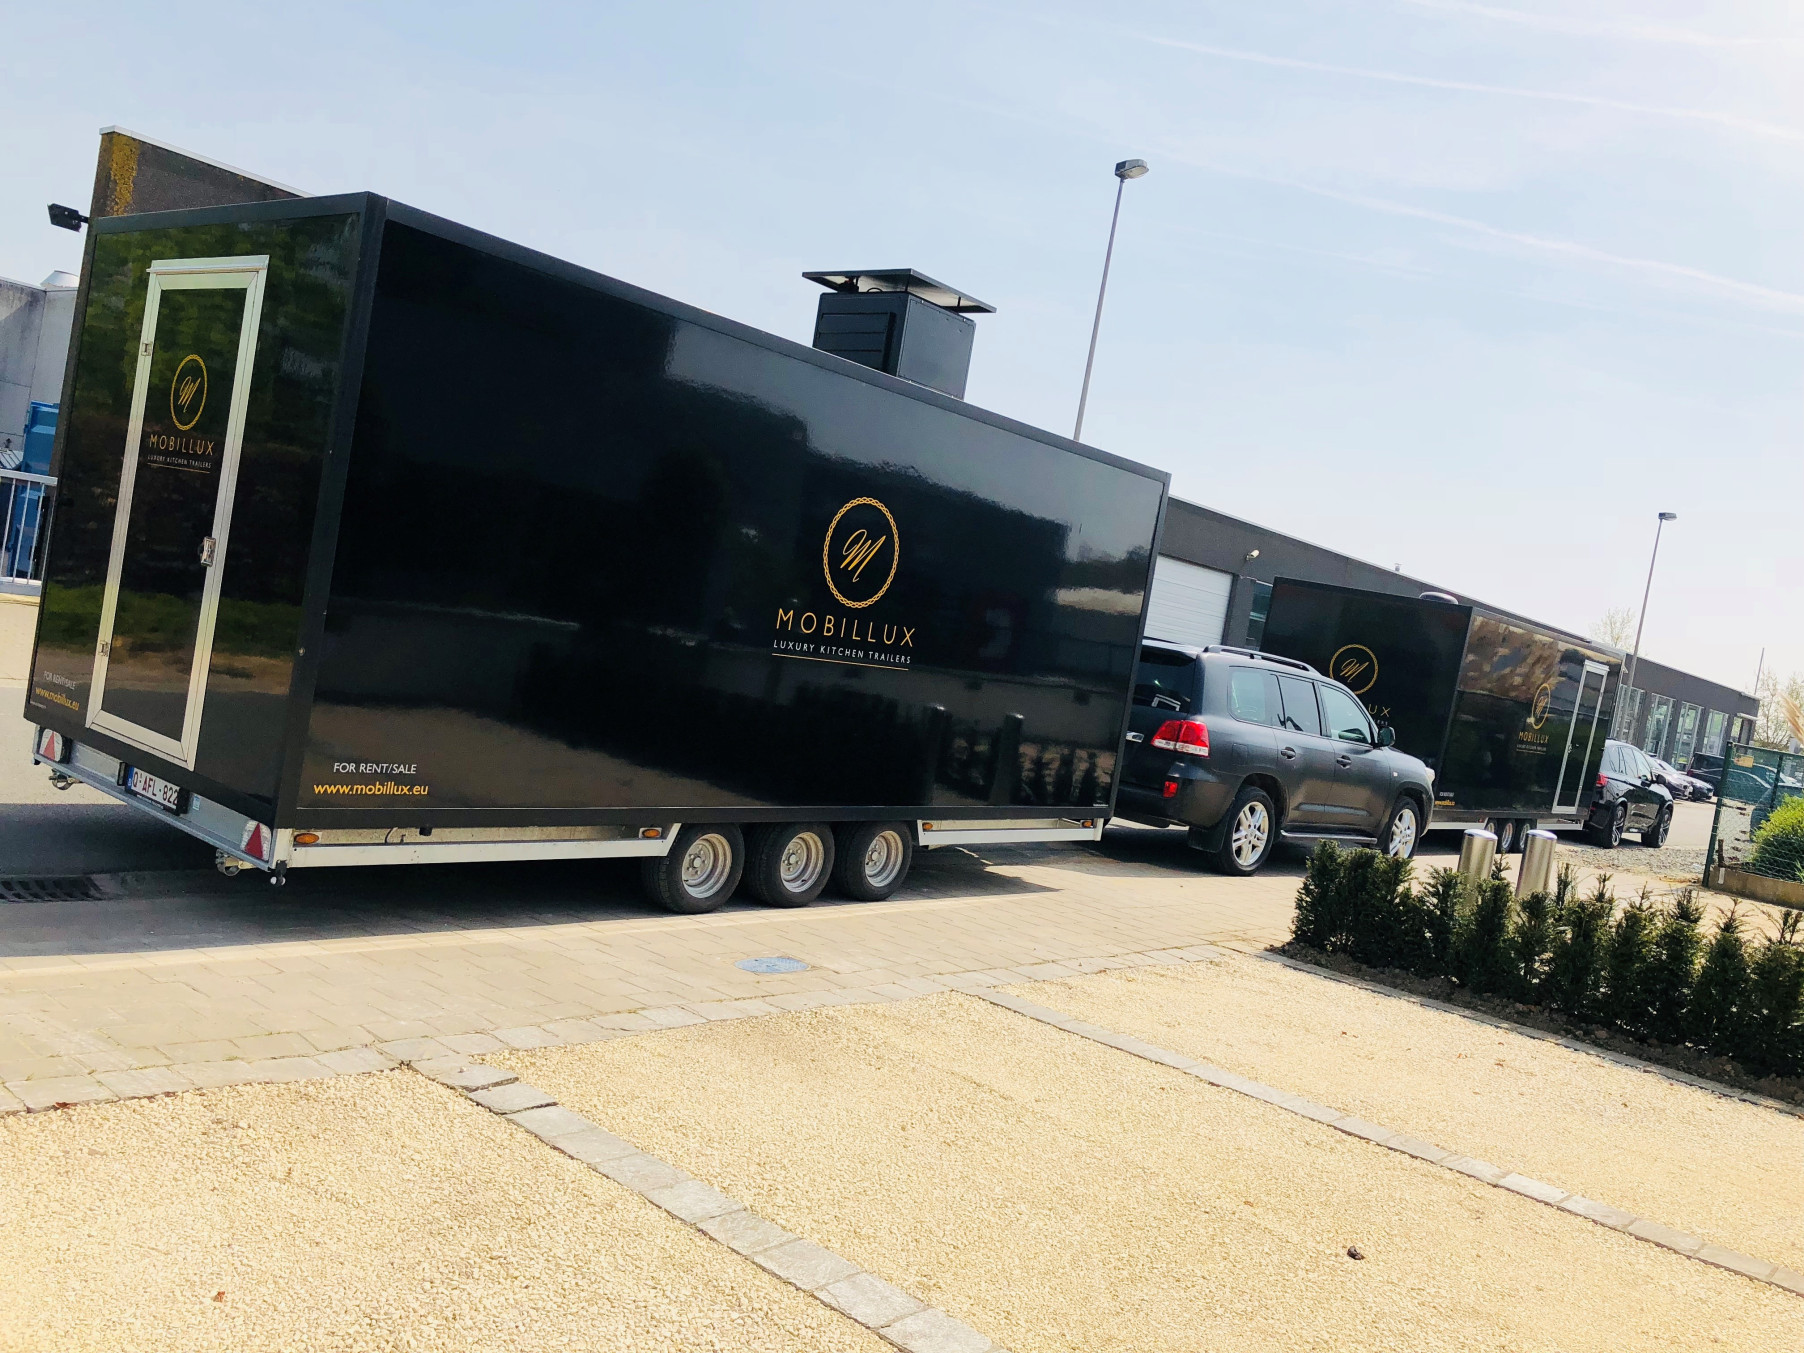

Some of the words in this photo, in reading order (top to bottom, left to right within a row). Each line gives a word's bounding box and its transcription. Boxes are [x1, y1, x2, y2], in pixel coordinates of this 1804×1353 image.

[149, 434, 215, 456] MOBILLUX
[147, 454, 166, 462] LUXURY
[167, 456, 188, 465] KITCHEN
[189, 459, 212, 469] TRAILERS
[776, 608, 916, 648] MOBILLUX
[773, 639, 815, 653] LUXURY
[819, 645, 864, 659] KITCHEN
[868, 651, 911, 664] TRAILERS
[1518, 731, 1549, 744] MOBILLUX
[333, 762, 356, 773] FOR
[359, 763, 417, 774] RENT/SALE
[313, 781, 429, 795] www.mobillux.eu
